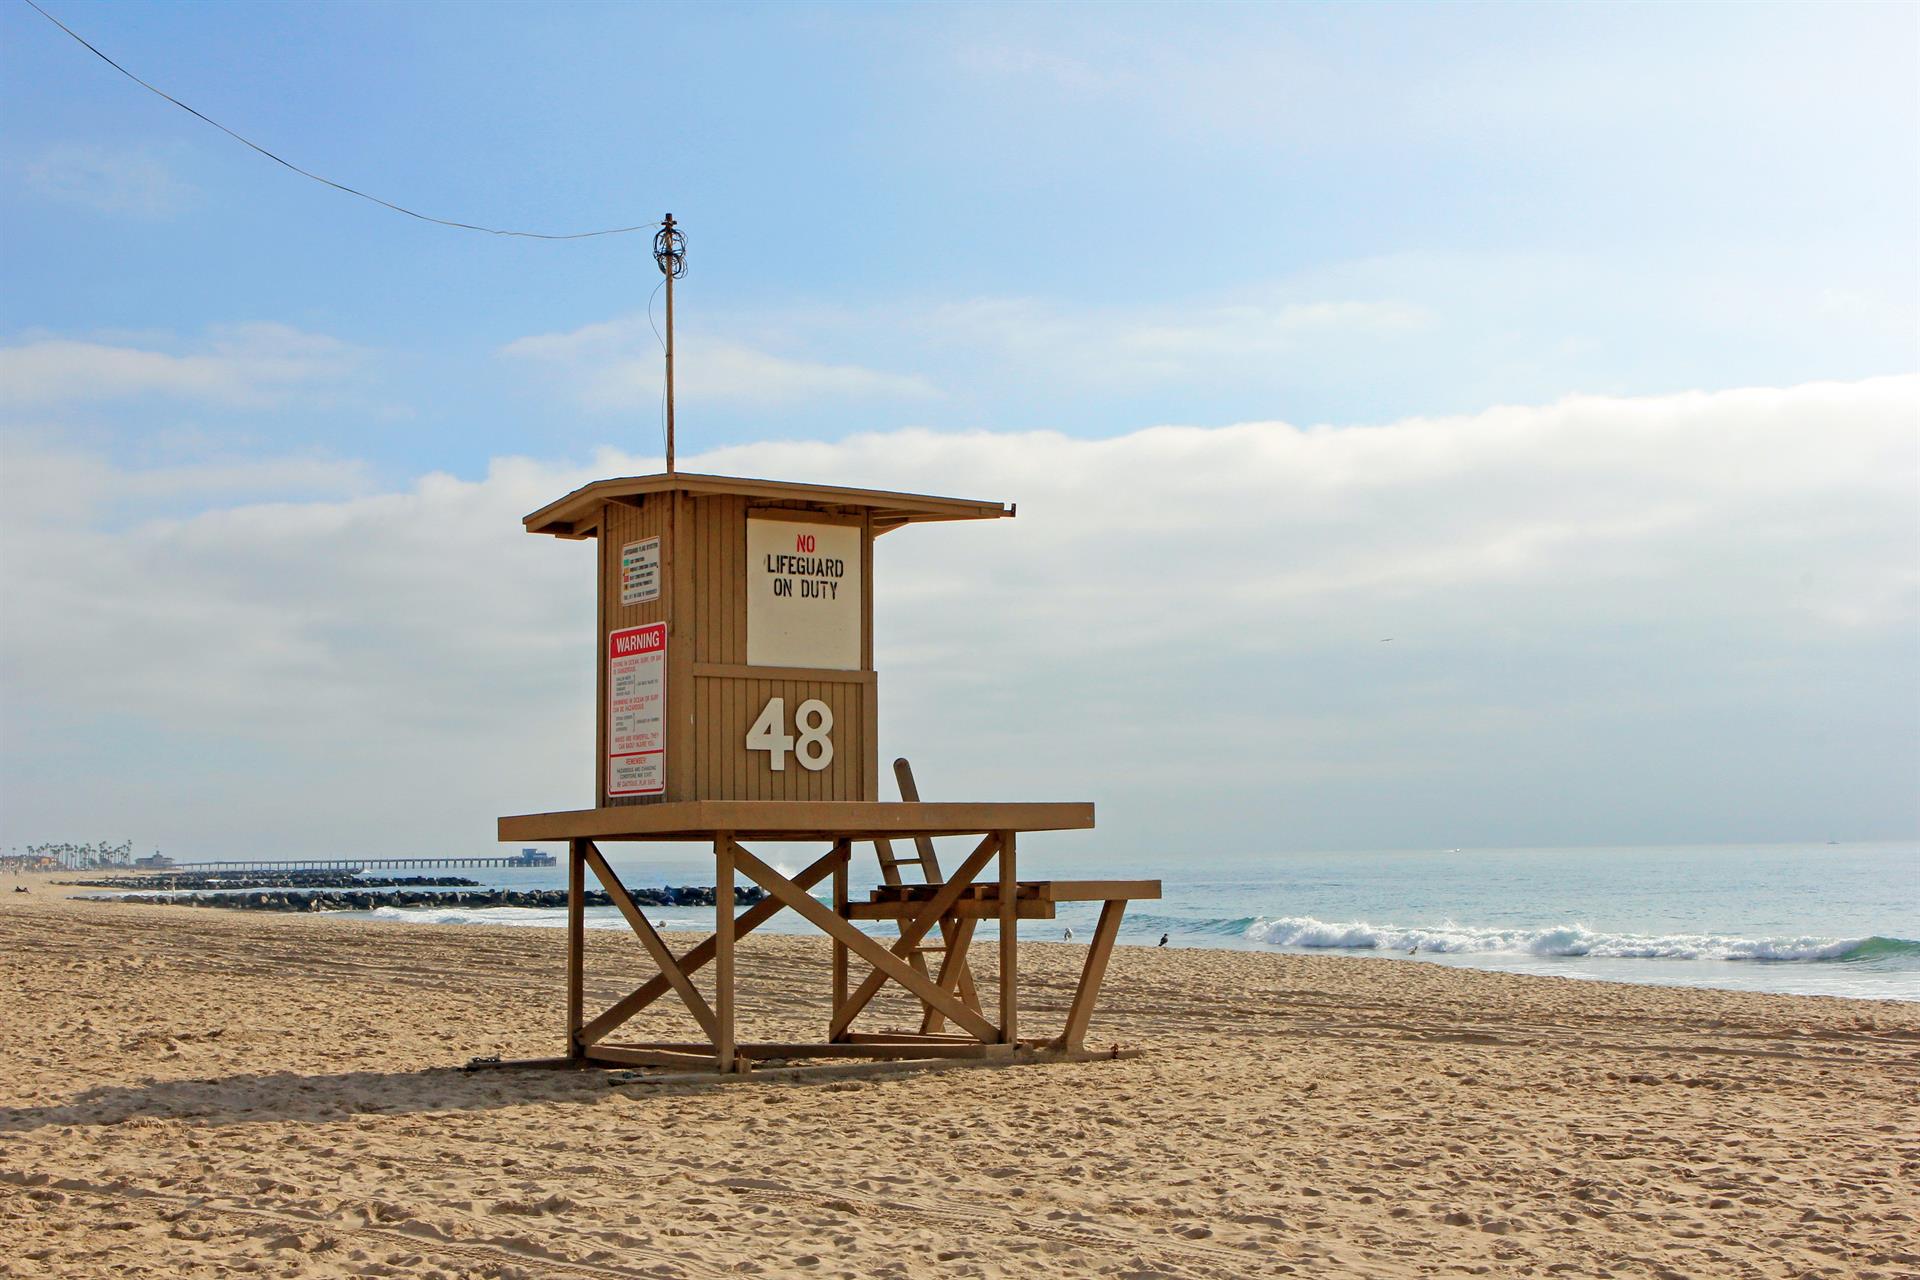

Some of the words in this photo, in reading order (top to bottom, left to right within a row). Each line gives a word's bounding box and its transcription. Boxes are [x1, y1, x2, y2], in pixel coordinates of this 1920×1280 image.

[796, 534, 815, 553] NO
[767, 554, 844, 577] LIFEGUARD
[773, 578, 792, 597] ON
[801, 579, 838, 600] DUTY
[616, 631, 660, 653] WARNING
[745, 697, 834, 771] 48
